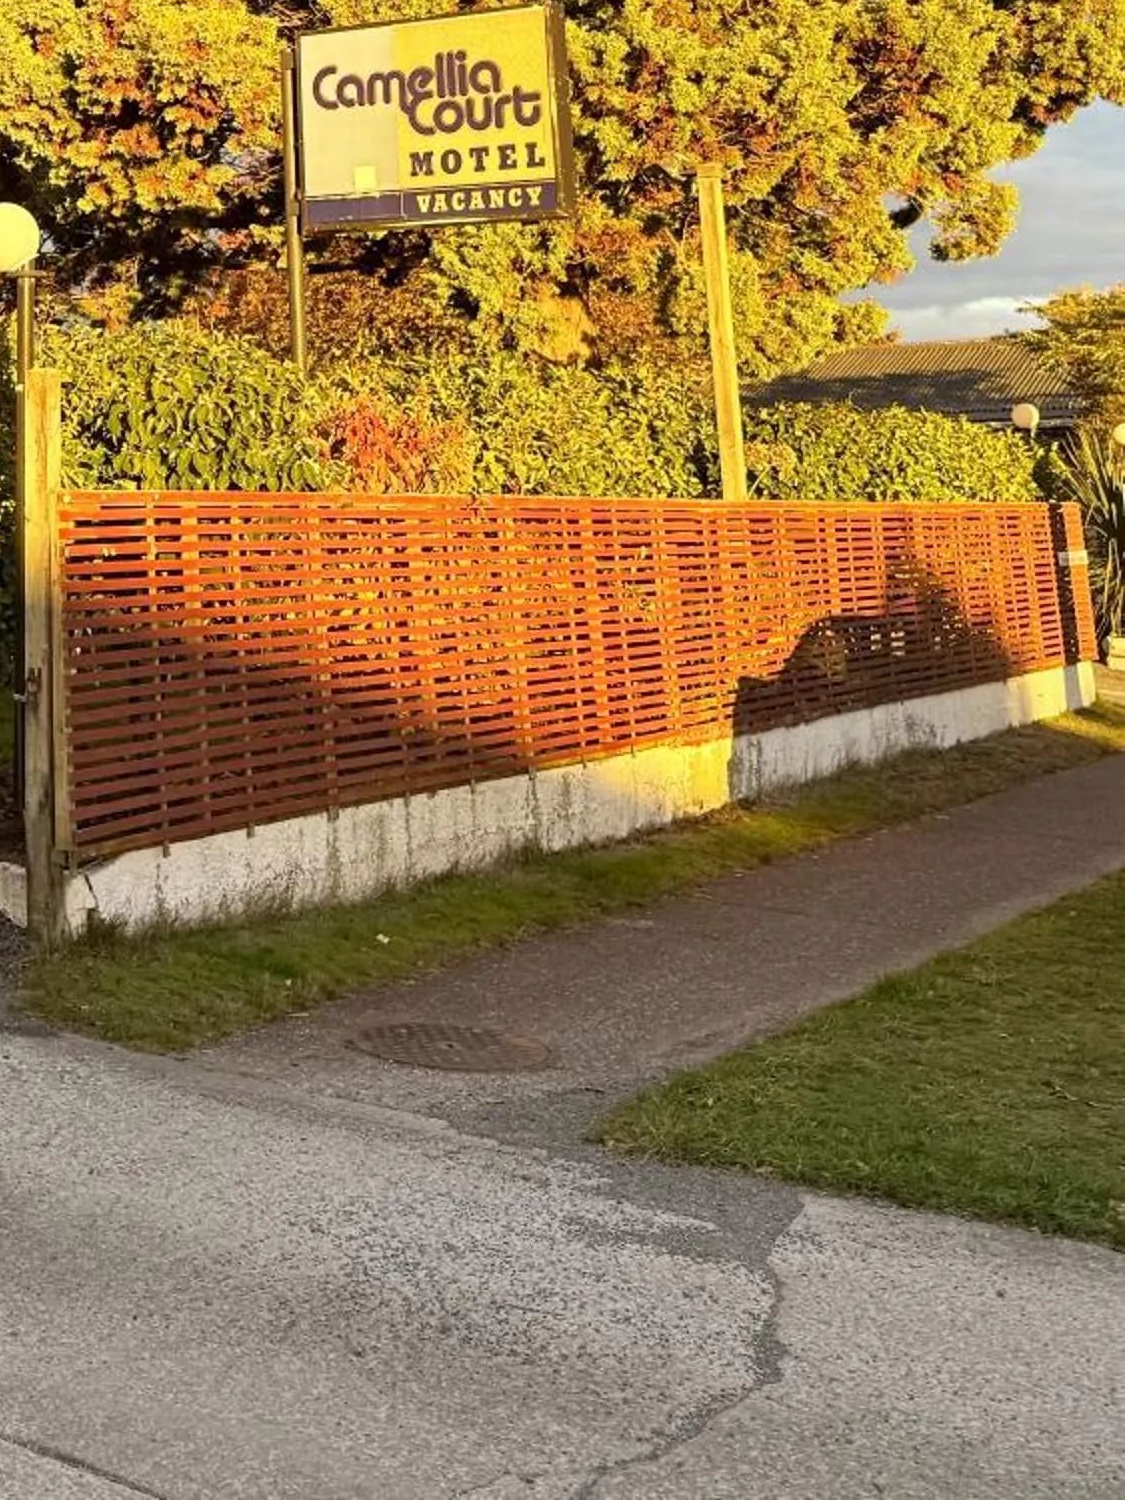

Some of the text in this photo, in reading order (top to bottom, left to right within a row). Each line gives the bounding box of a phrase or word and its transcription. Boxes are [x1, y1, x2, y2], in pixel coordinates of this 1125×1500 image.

[312, 50, 502, 113] Camellia
[409, 142, 546, 177] MOTEL
[416, 186, 543, 214] VACANCY
